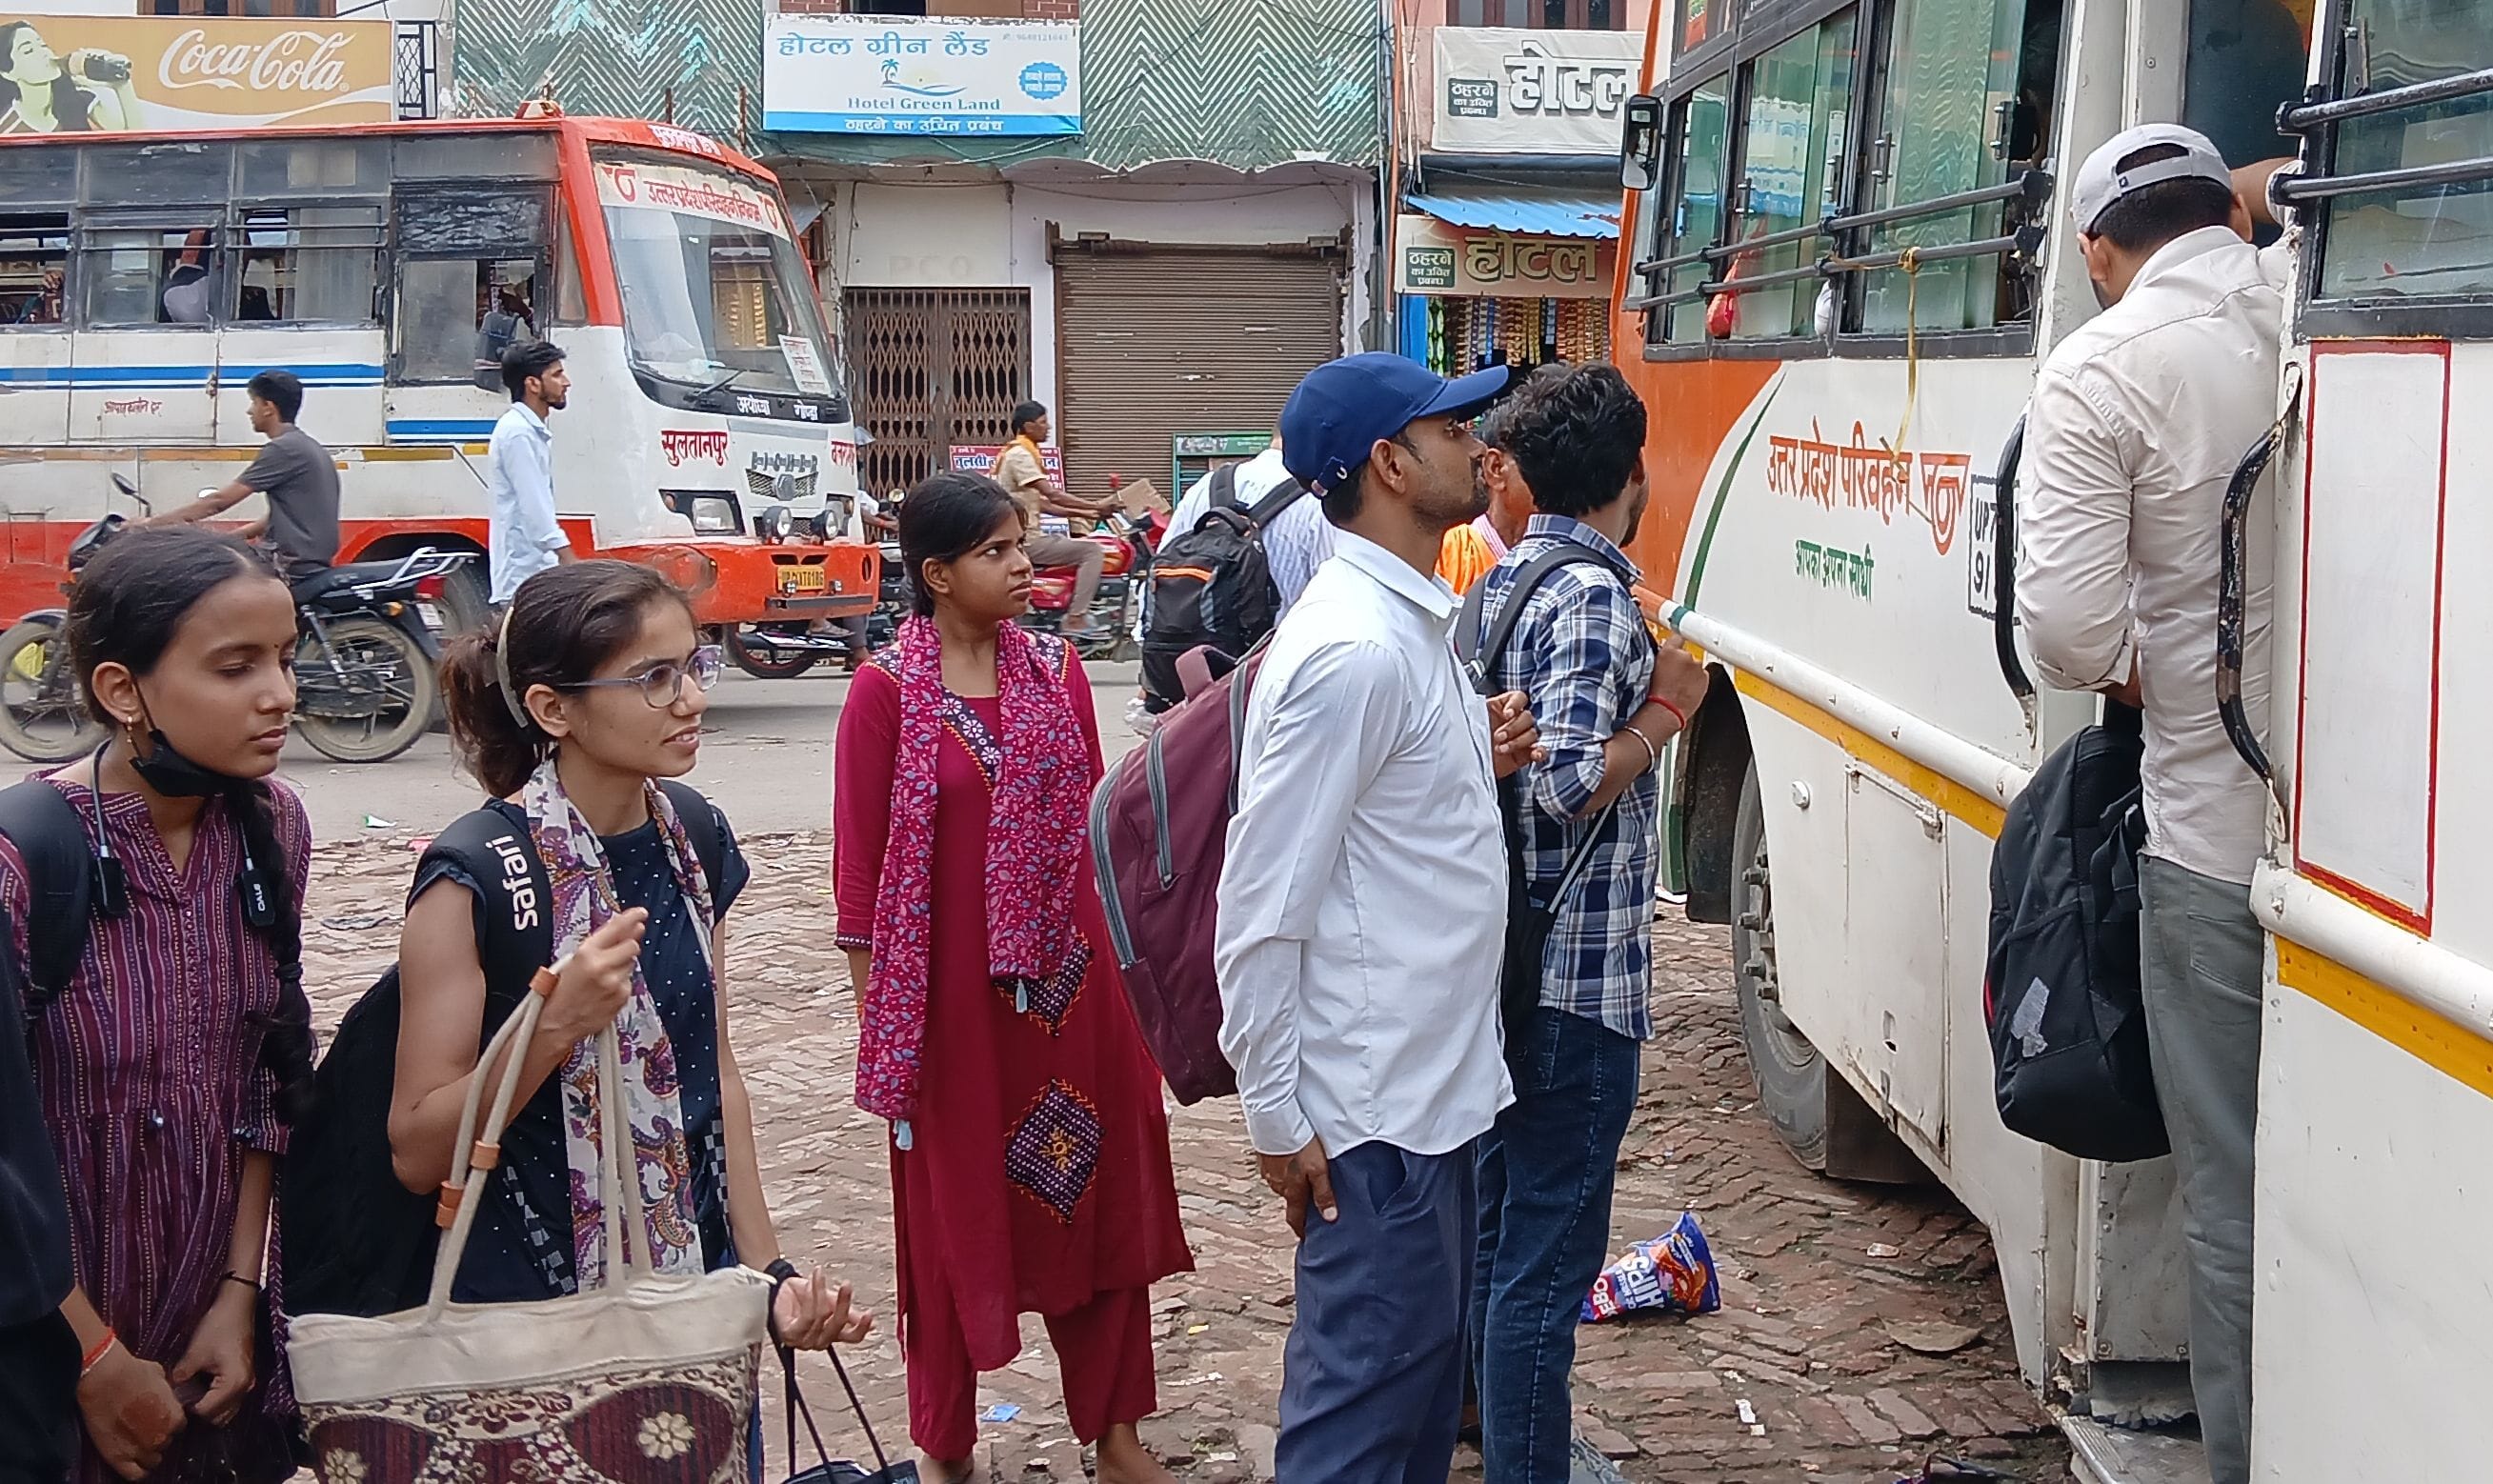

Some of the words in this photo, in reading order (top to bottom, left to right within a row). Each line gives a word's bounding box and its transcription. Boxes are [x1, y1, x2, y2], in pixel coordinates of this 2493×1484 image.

[158, 30, 357, 90] Coca-Cola
[777, 32, 854, 55] होटल
[864, 31, 932, 55] ग्रीन
[942, 30, 991, 55] लैंड
[1451, 82, 1495, 96] ठहरने
[1503, 40, 1642, 115] होटल
[848, 97, 895, 110] Hotel
[900, 98, 953, 110] Green
[957, 98, 1001, 110] Land
[893, 119, 914, 130] का
[918, 116, 961, 131] उचित
[1409, 250, 1453, 266] ठहरने
[1411, 268, 1425, 276] का
[1426, 267, 1451, 276] उचित
[1464, 227, 1601, 283] होटल
[661, 431, 729, 467] सुलतानपुर
[1767, 435, 1799, 498] उत्तर
[1799, 415, 1839, 513] प्रदेश
[1840, 420, 1914, 527] परिवहन
[486, 835, 538, 931] safari
[1621, 1255, 1665, 1309] HIPS
